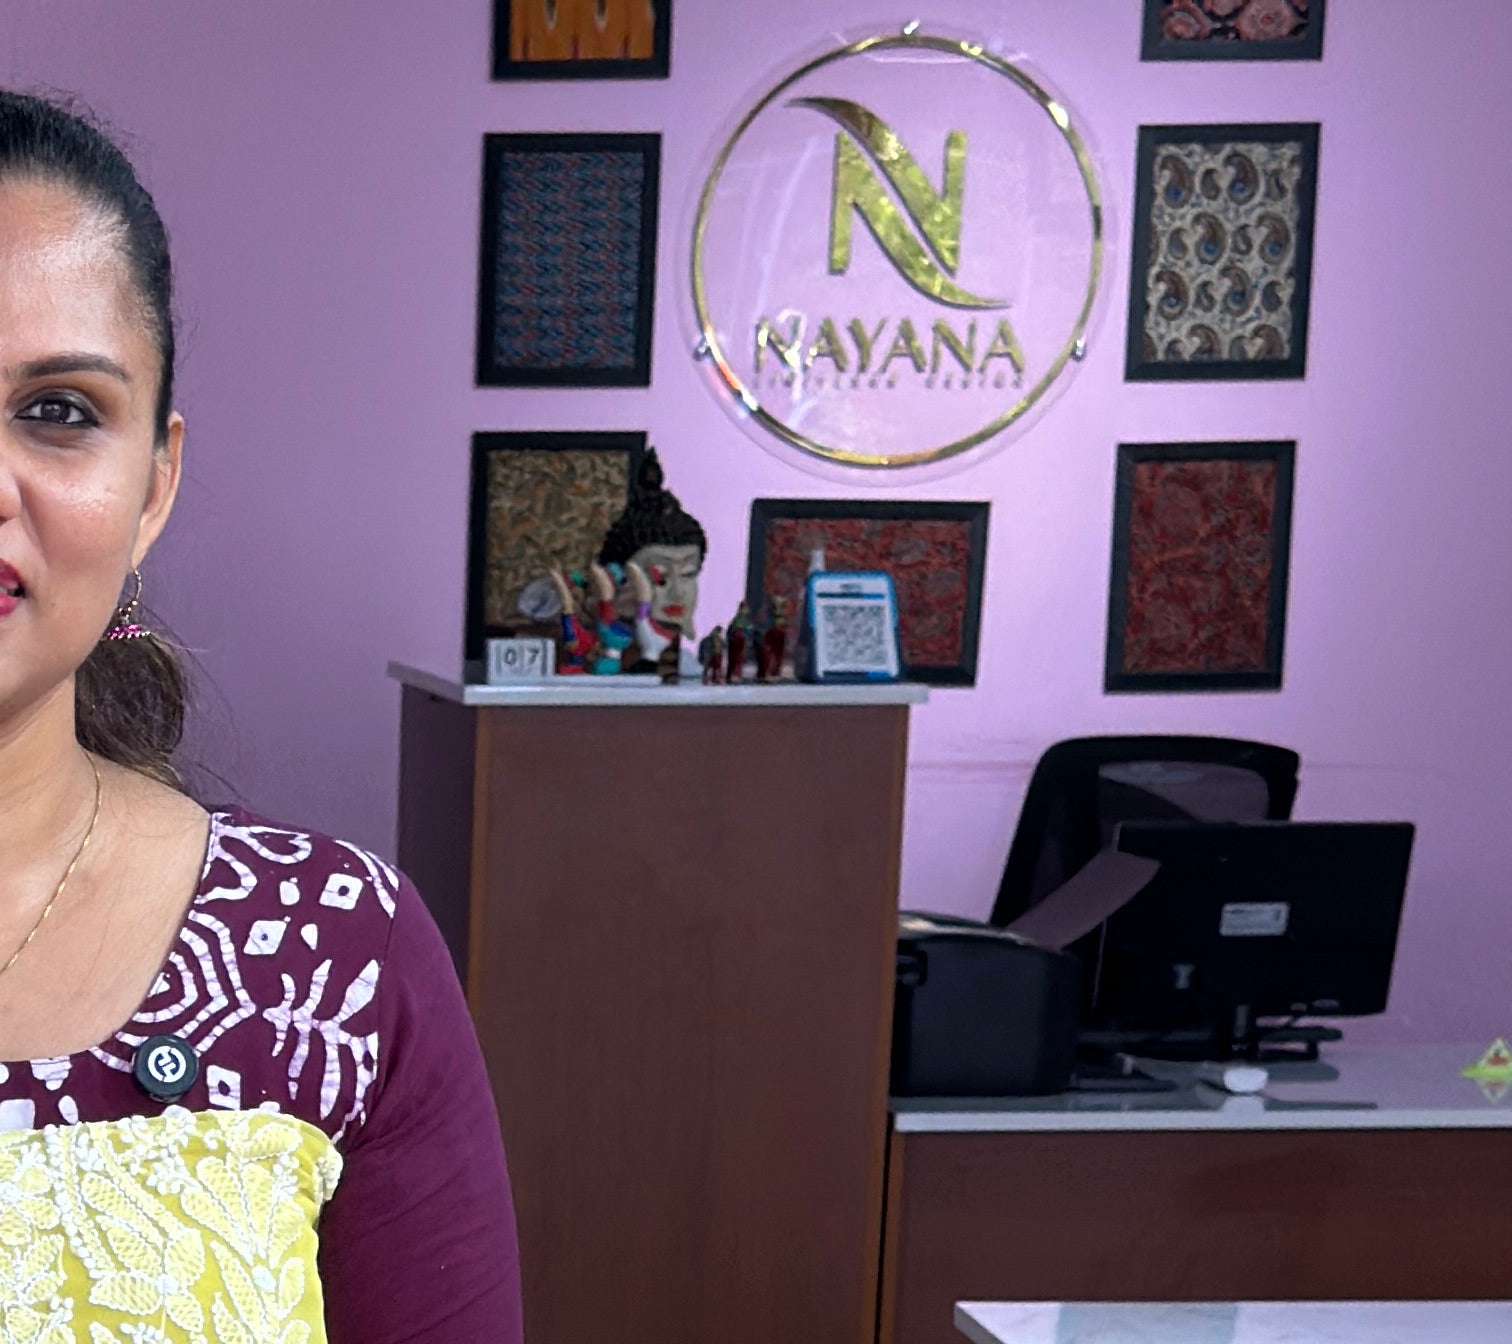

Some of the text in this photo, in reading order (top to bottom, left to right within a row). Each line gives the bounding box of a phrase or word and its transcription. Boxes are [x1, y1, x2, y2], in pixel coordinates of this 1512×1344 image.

[786, 97, 1013, 311] N
[754, 316, 1025, 374] NAYANA
[503, 646, 540, 666] 07
